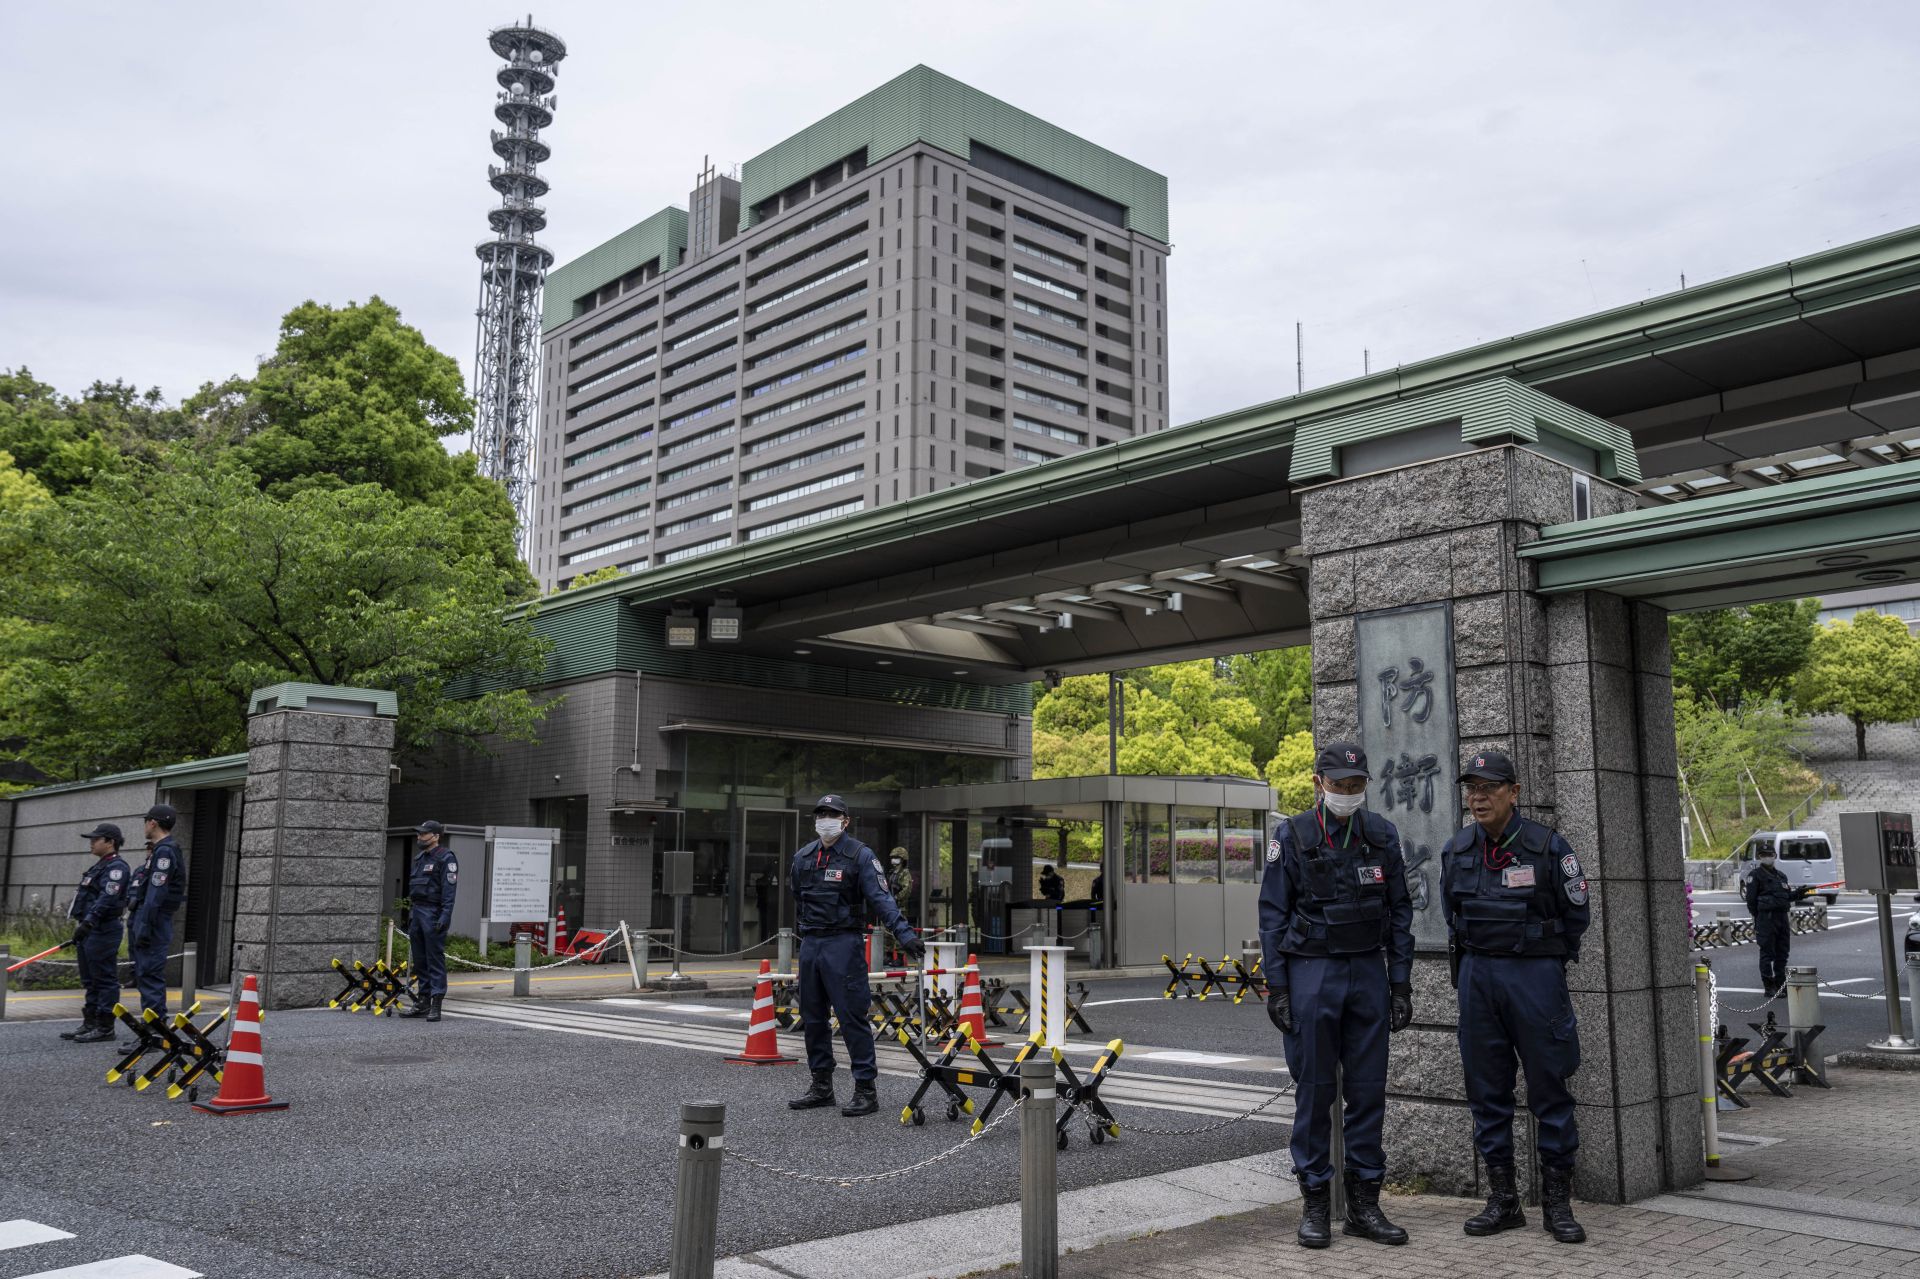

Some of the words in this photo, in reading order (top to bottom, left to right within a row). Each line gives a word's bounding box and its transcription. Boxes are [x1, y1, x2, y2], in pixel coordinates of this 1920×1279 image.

[826, 870, 842, 878] KSS
[1360, 867, 1383, 880] KSS
[1568, 881, 1586, 895] KSS
